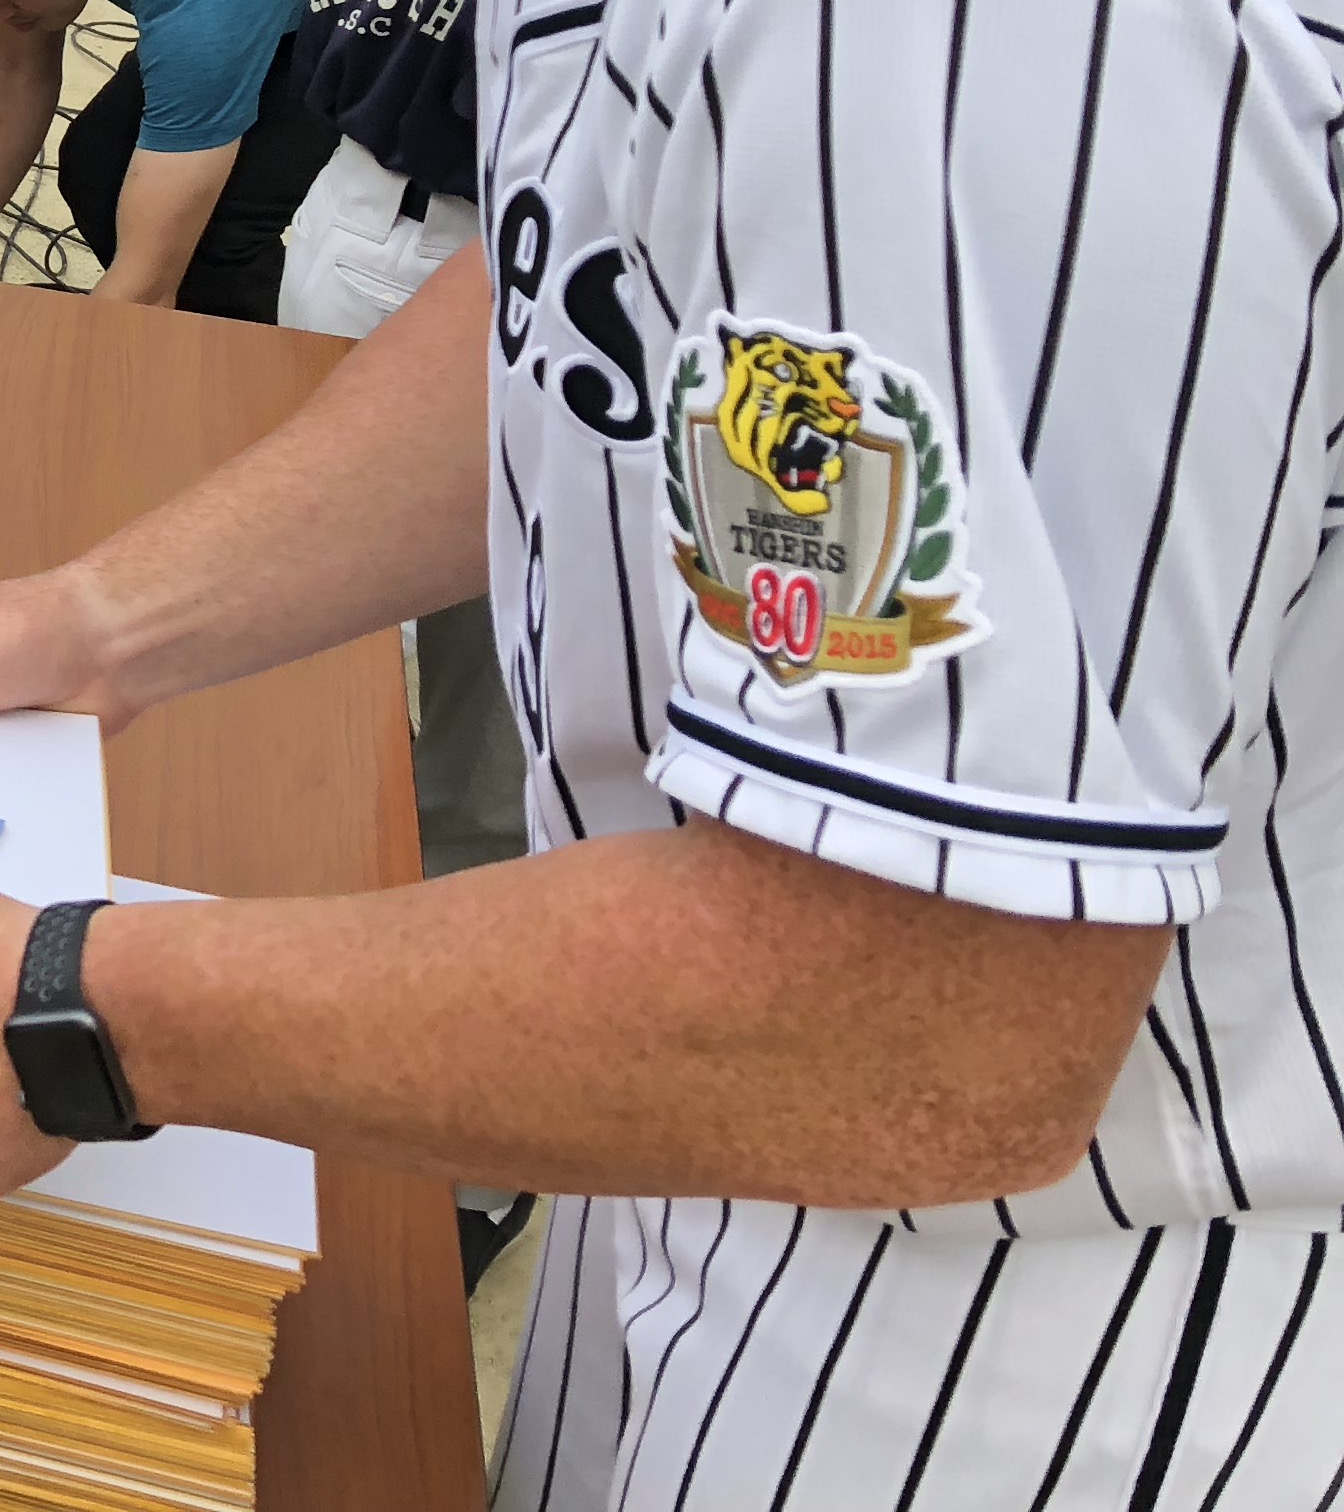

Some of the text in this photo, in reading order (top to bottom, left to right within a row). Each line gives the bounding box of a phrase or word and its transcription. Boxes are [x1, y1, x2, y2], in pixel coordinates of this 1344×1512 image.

[729, 524, 848, 575] TIGERS
[750, 566, 823, 658] 80
[827, 631, 898, 660] 2015
